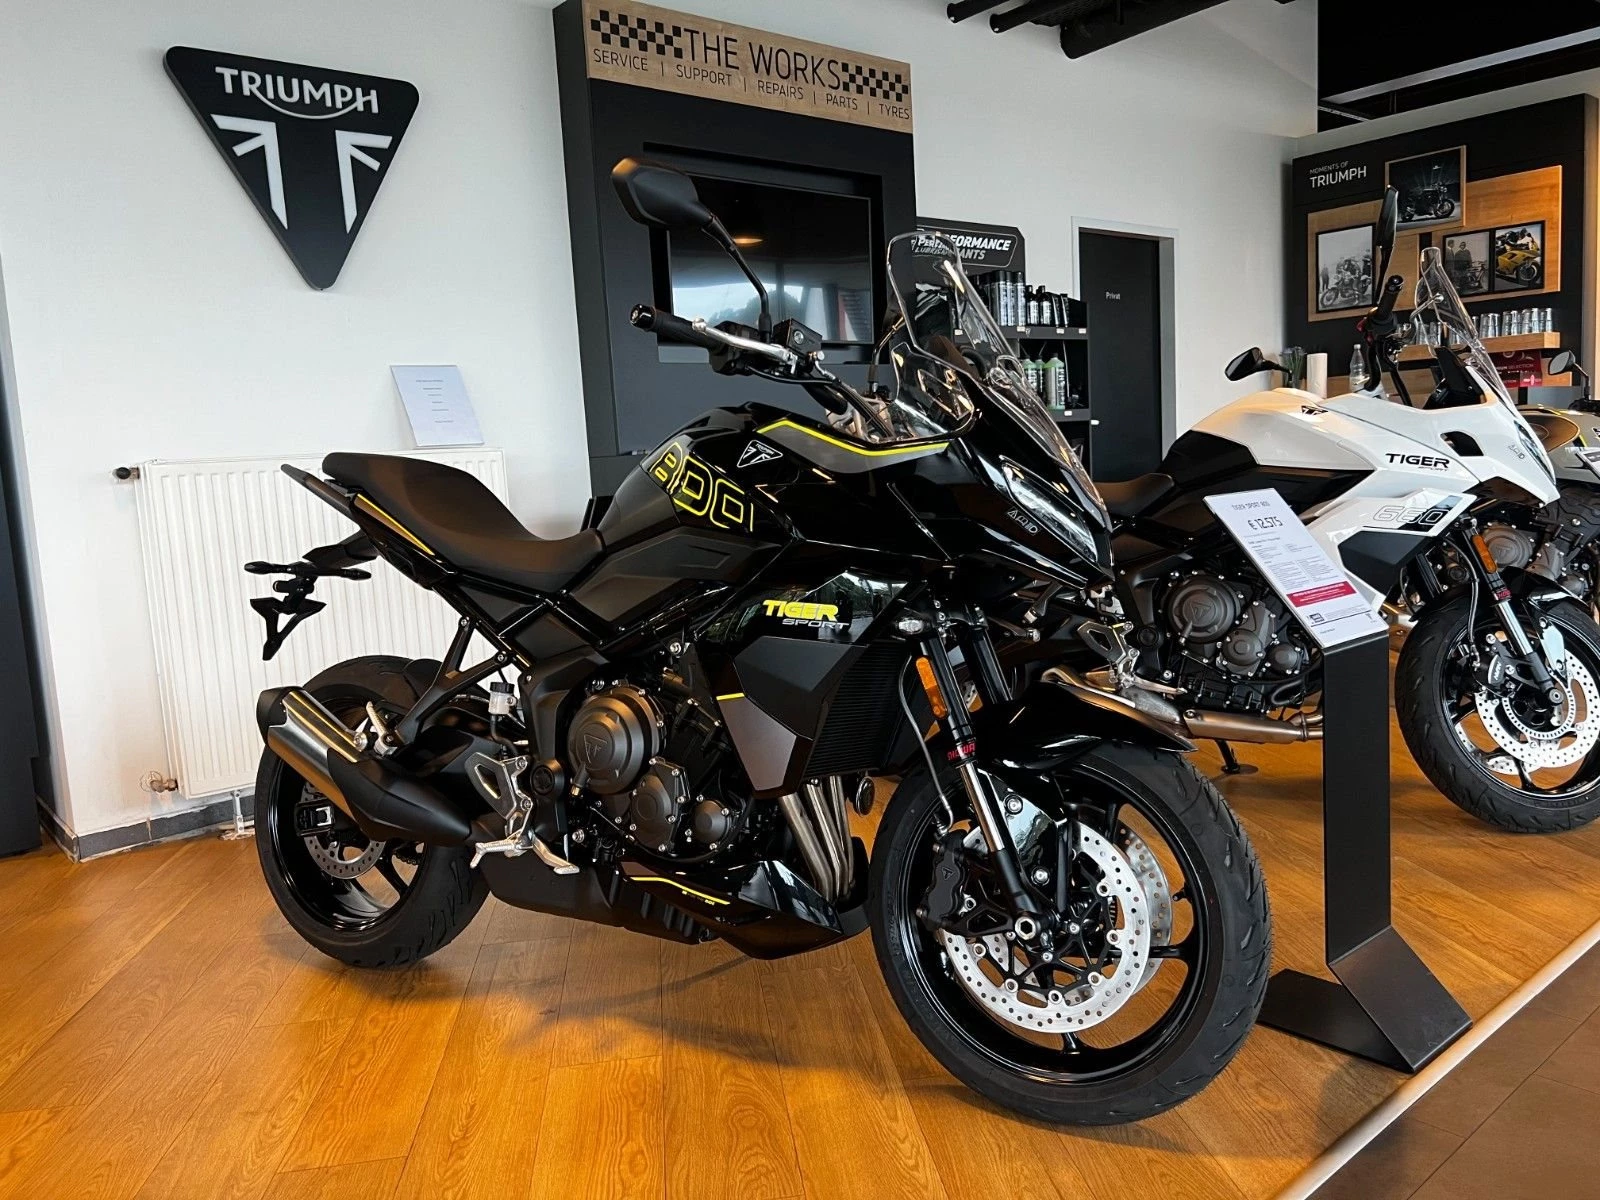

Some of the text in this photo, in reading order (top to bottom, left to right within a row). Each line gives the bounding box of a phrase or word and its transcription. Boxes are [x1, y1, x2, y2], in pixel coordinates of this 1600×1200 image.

[683, 28, 842, 91] THE WORKS
[215, 66, 379, 117] TRIUMPH
[592, 49, 911, 120] SERVICE SUPPORT REPAIRS PARTS TYRES
[1309, 160, 1349, 174] MOMENTS OF
[1309, 165, 1367, 188] TRIUMPH
[1385, 453, 1450, 469] TIGER
[762, 599, 839, 622] TIGER
[781, 618, 849, 630] SPORT
